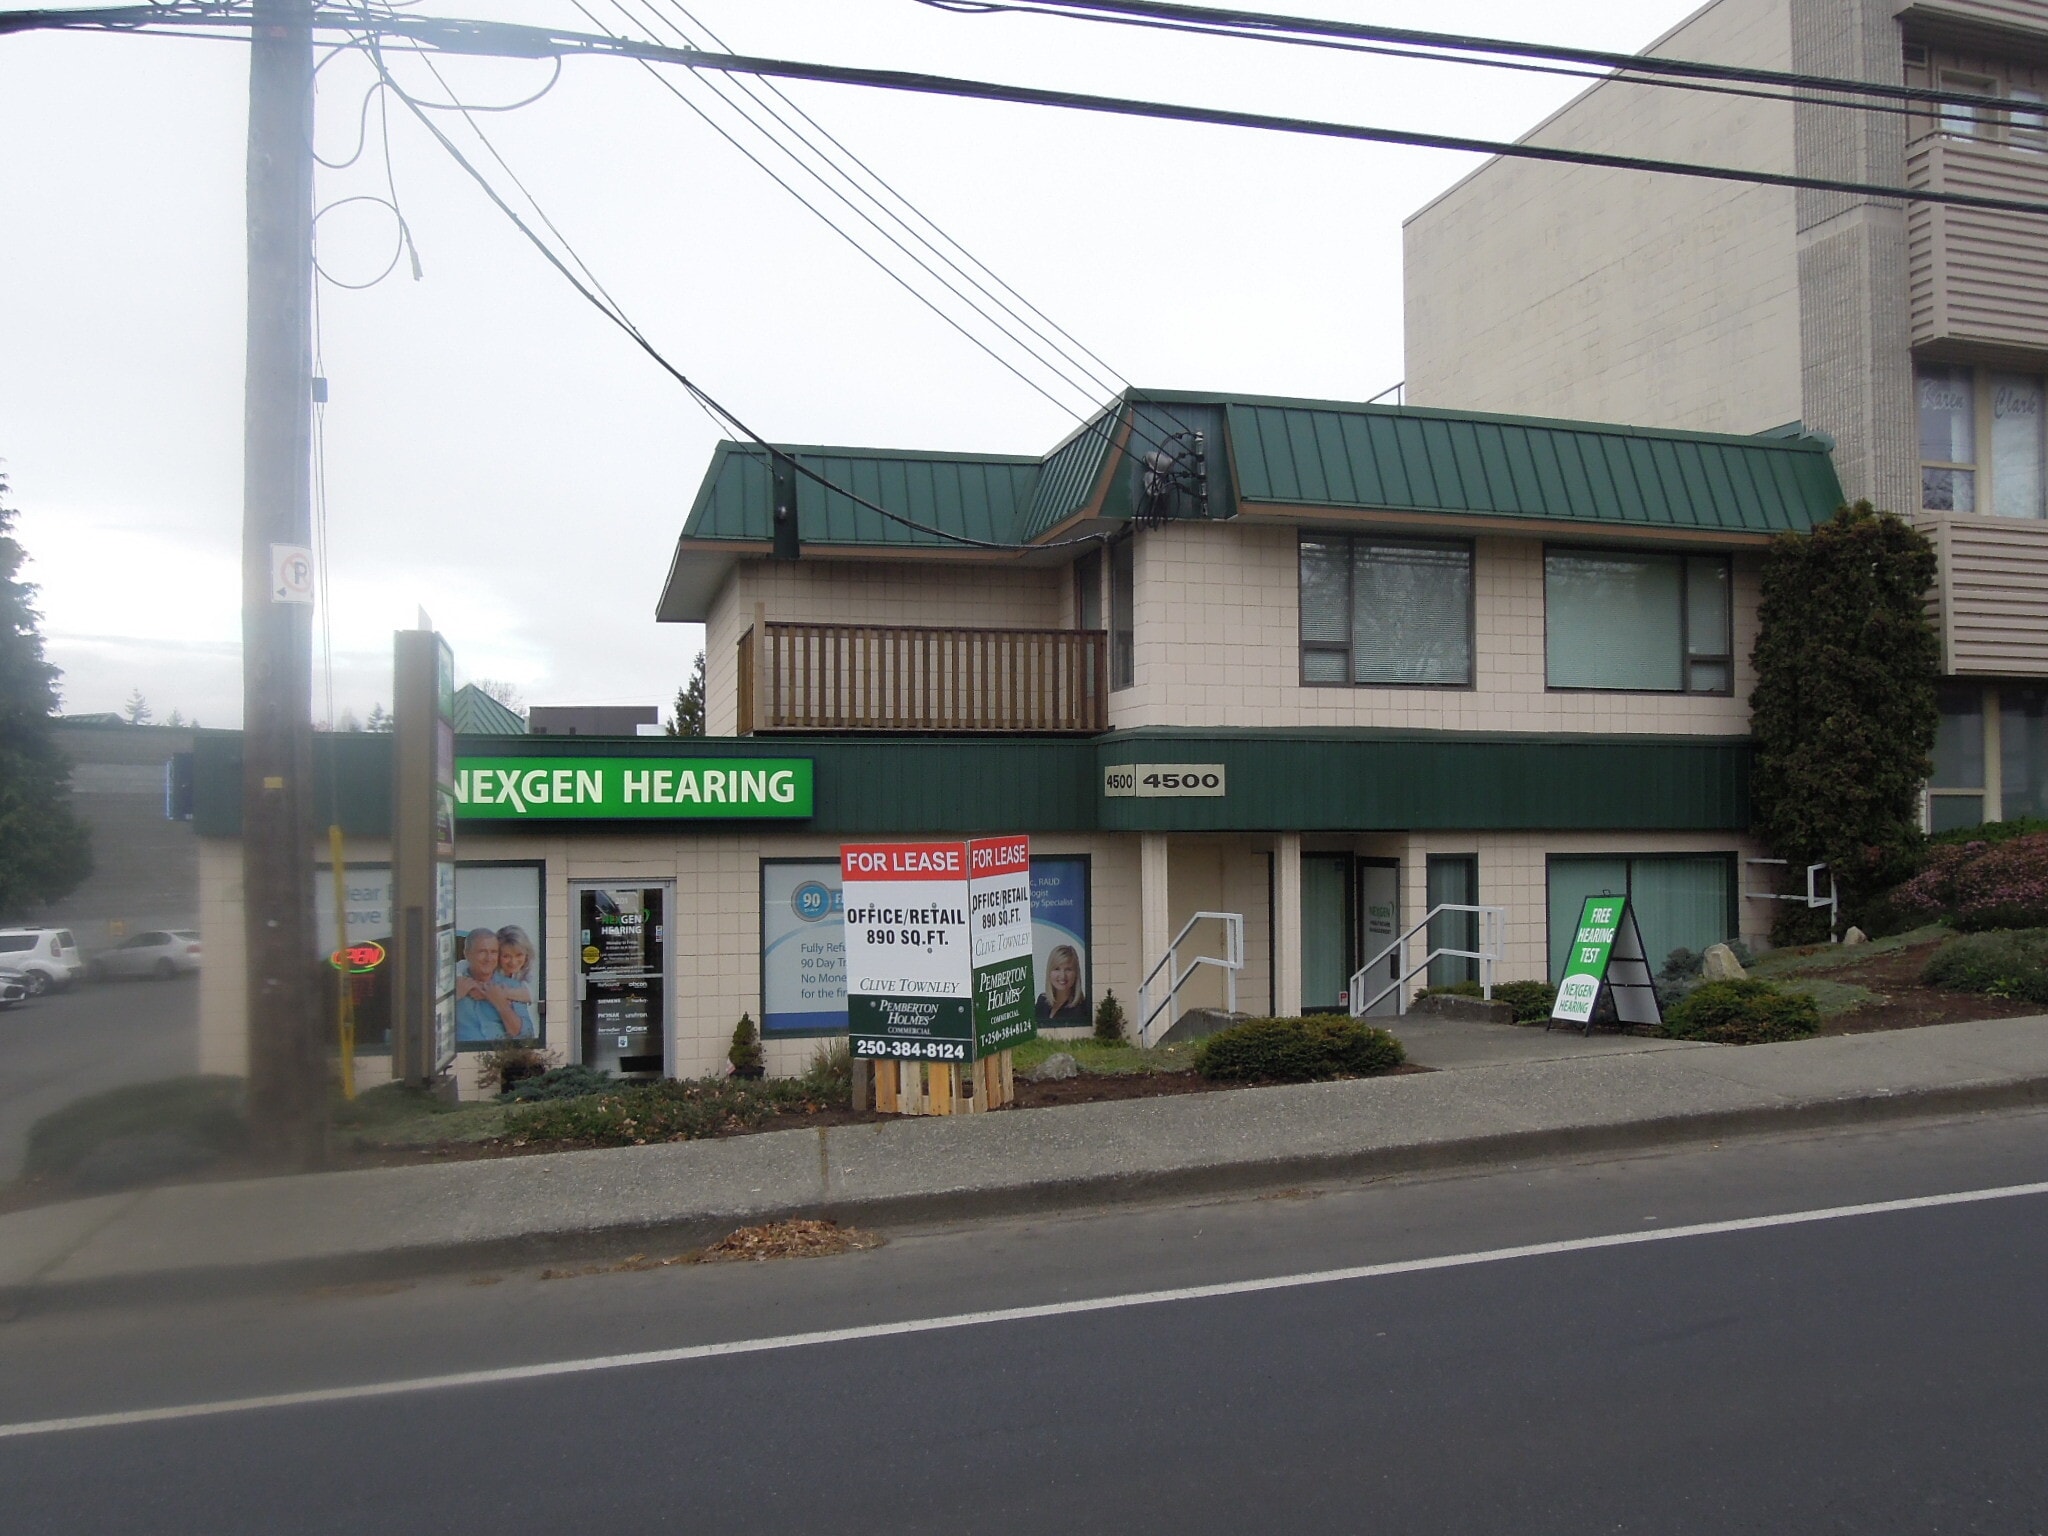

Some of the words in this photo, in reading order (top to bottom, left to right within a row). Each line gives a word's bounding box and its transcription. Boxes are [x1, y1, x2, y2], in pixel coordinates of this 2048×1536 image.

[1106, 774, 1133, 789] 4500
[1142, 773, 1220, 789] 4500
[454, 769, 603, 813] NEXGEN
[623, 769, 795, 804] HEARING
[846, 852, 888, 872] FOR
[892, 851, 960, 872] LEASE
[972, 848, 993, 869] FOR
[995, 844, 1026, 866] LEASE
[802, 892, 821, 908] 90
[972, 886, 1028, 911] OFFICE/RETAIL
[1041, 898, 1074, 908] Specialist
[847, 908, 966, 926] OFFICE/RETAIL
[982, 912, 996, 929] 890
[998, 908, 1021, 927] SQ.FT.
[1590, 907, 1613, 924] FREE
[601, 926, 643, 935] HEARING
[866, 929, 895, 945] 890
[900, 929, 949, 947] SQ.FT.
[1577, 927, 1615, 943] HEARING
[801, 942, 825, 955] Fully
[975, 938, 996, 957] CLIVE
[997, 932, 1030, 951] TOWNLEY
[1579, 947, 1601, 963] TEST
[801, 958, 814, 968] 90
[816, 957, 835, 970] Day
[801, 973, 816, 983] No
[818, 973, 847, 983] Mone
[859, 977, 896, 992] CLIVE
[899, 978, 960, 994] TOWNLEY
[979, 965, 1028, 993] PEMBERTON
[801, 988, 815, 999] for
[818, 988, 834, 999] the
[987, 986, 1024, 1012] HOLMES
[1563, 982, 1595, 1000] NEXGEN
[879, 999, 940, 1015] PEMBERTON
[1558, 1000, 1590, 1014] HEARING
[887, 1011, 935, 1026] HOLMES
[990, 1009, 1020, 1025] COMMERCIAL
[887, 1026, 932, 1036] COMMERCIAL
